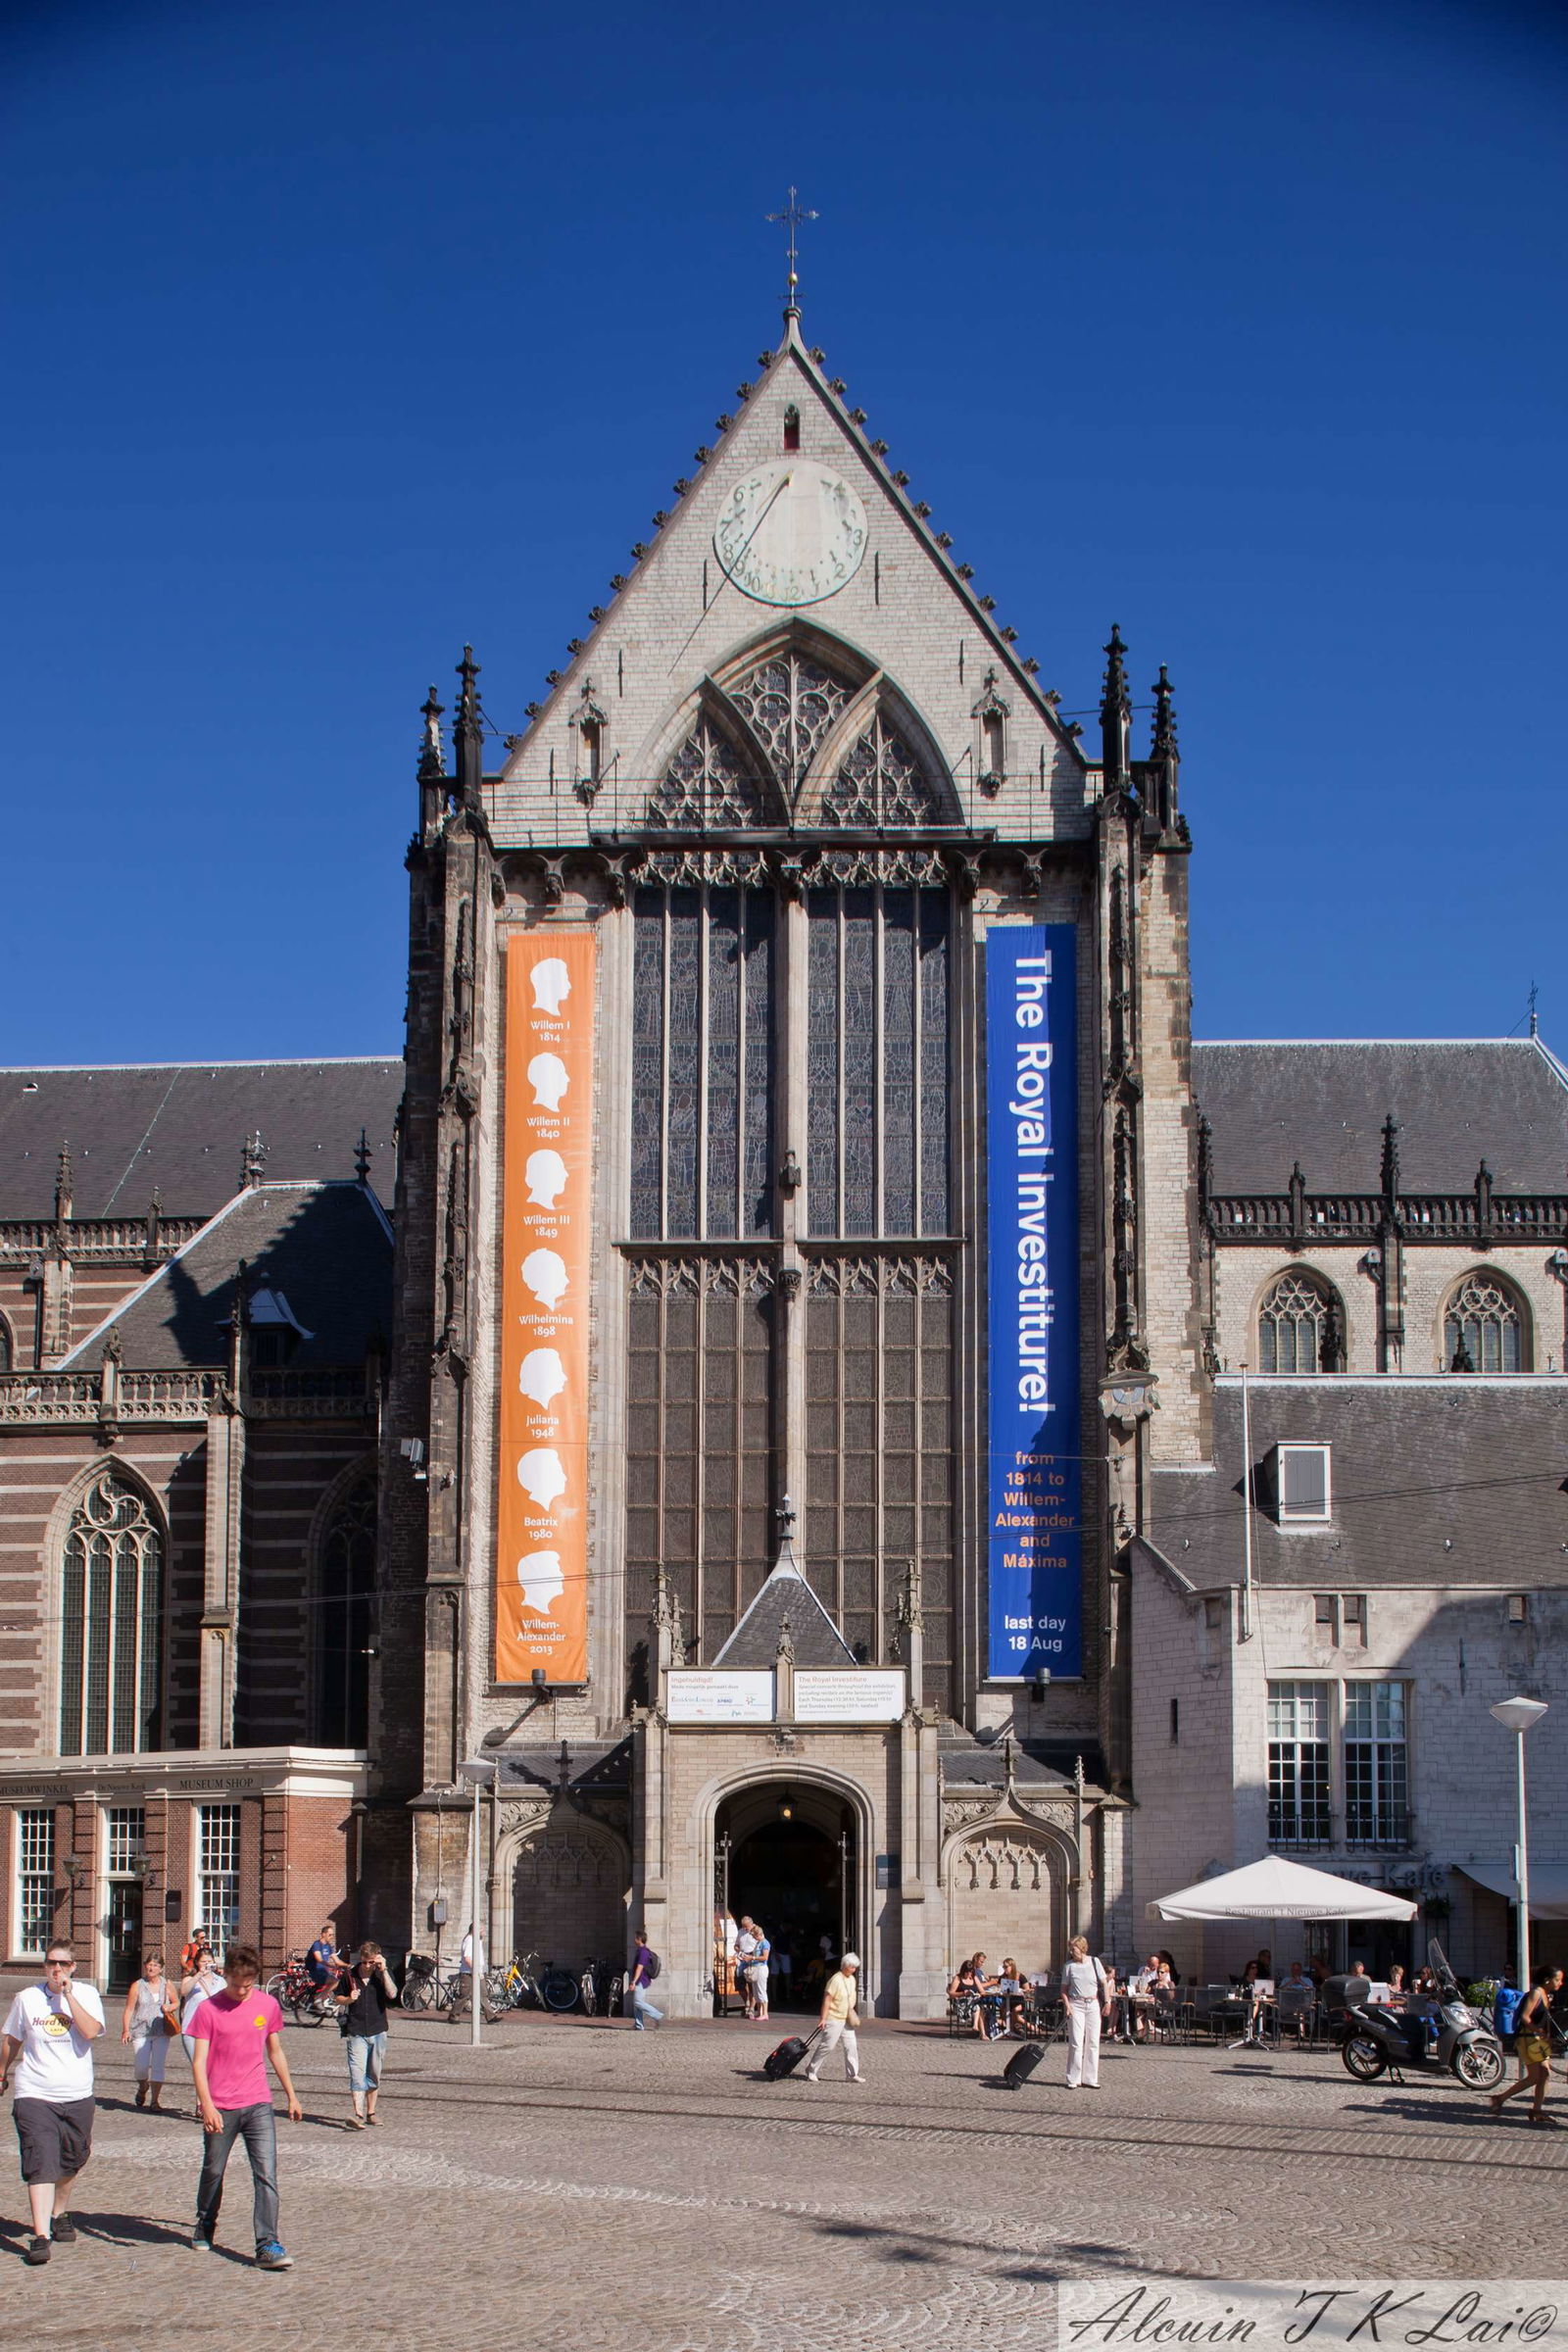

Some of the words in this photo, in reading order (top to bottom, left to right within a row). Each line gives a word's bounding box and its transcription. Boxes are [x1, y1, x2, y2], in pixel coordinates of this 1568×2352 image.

[733, 484, 745, 503] 6
[853, 529, 862, 546] 3
[723, 544, 733, 561] 8
[834, 563, 846, 579] 2
[1015, 950, 1053, 1028] The
[530, 1020, 564, 1031] Willem
[565, 1020, 571, 1030] I
[539, 1032, 561, 1043] 1814
[1008, 1043, 1054, 1157] Royal
[526, 1116, 560, 1127] Willem
[561, 1116, 570, 1126] II
[536, 1129, 560, 1139] 1840
[523, 1215, 557, 1226] Willem
[558, 1214, 570, 1224] III
[534, 1227, 559, 1238] 1849
[1016, 1173, 1055, 1412] Investiture!
[518, 1314, 574, 1325] Wilhelmina
[532, 1326, 557, 1337] 1898
[525, 1414, 560, 1426] Juliana
[530, 1427, 555, 1439] 1948
[1015, 1450, 1054, 1465] from
[1006, 1473, 1043, 1487] 1814
[1049, 1472, 1065, 1487] to
[1004, 1492, 1065, 1506] Willem-
[523, 1516, 558, 1528] Beatrix
[995, 1512, 1075, 1528] Alexander
[528, 1528, 554, 1540] 1980
[1019, 1533, 1051, 1547] and
[1003, 1553, 1067, 1568] Máxima
[522, 1619, 561, 1631] Willem-
[1004, 1615, 1034, 1630] last
[1038, 1615, 1066, 1632] day
[516, 1631, 566, 1642] Alexander
[529, 1643, 553, 1655] 2013
[1008, 1637, 1027, 1650] 18
[1031, 1636, 1062, 1651] Aug
[179, 1779, 223, 1789] MUSEUM
[226, 1778, 254, 1788] SHOP
[1225, 1906, 1275, 1916] Restaurant
[1287, 1906, 1323, 1916] Nieuwe
[32, 2017, 57, 2026] Hard
